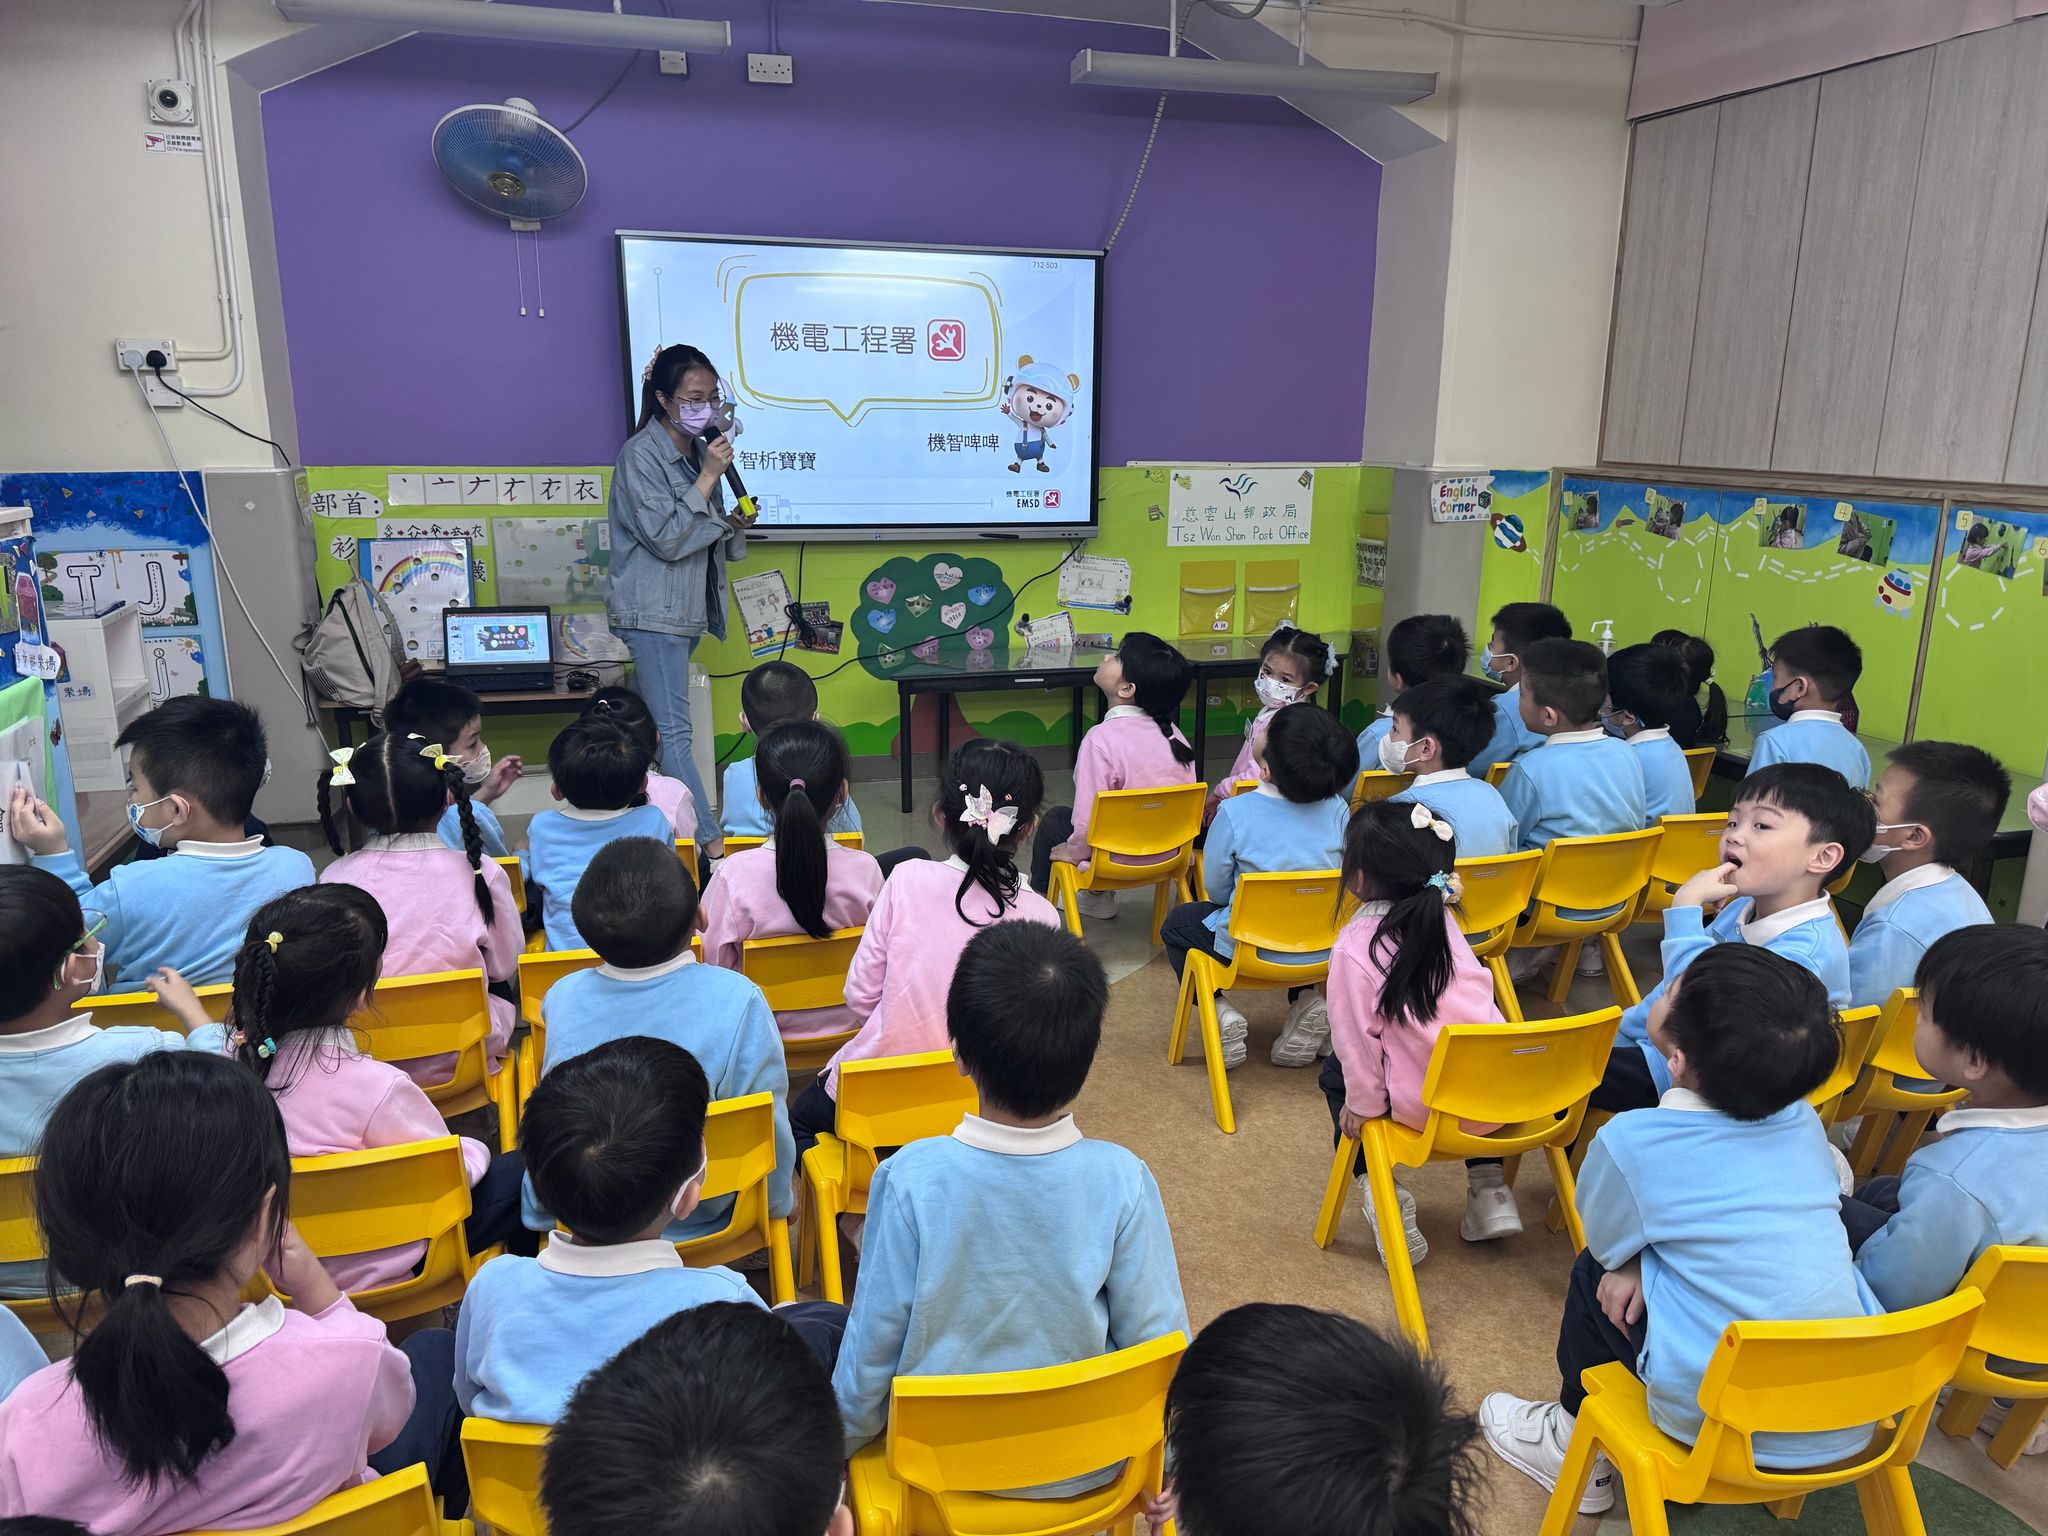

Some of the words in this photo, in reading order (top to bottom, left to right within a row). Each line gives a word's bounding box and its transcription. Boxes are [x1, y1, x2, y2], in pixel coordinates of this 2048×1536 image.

[1032, 261, 1058, 270] 712-503
[770, 321, 917, 355] 機電工程署
[927, 433, 1000, 452] 機智啤啤
[738, 450, 817, 471] 智析寶寶
[1440, 484, 1478, 501] English
[1017, 499, 1040, 508] EMSD
[1440, 501, 1477, 513] Corner
[1757, 500, 1765, 513] 3
[1839, 504, 1848, 519] 4
[1182, 503, 1298, 522] 慈雲山郵政局
[1961, 513, 1969, 527] 5
[1172, 526, 1196, 542] Tsz
[1253, 525, 1274, 540] Post
[1278, 525, 1309, 540] Office
[332, 537, 356, 560] 衫
[2039, 539, 2047, 556] 6
[138, 561, 167, 615] J
